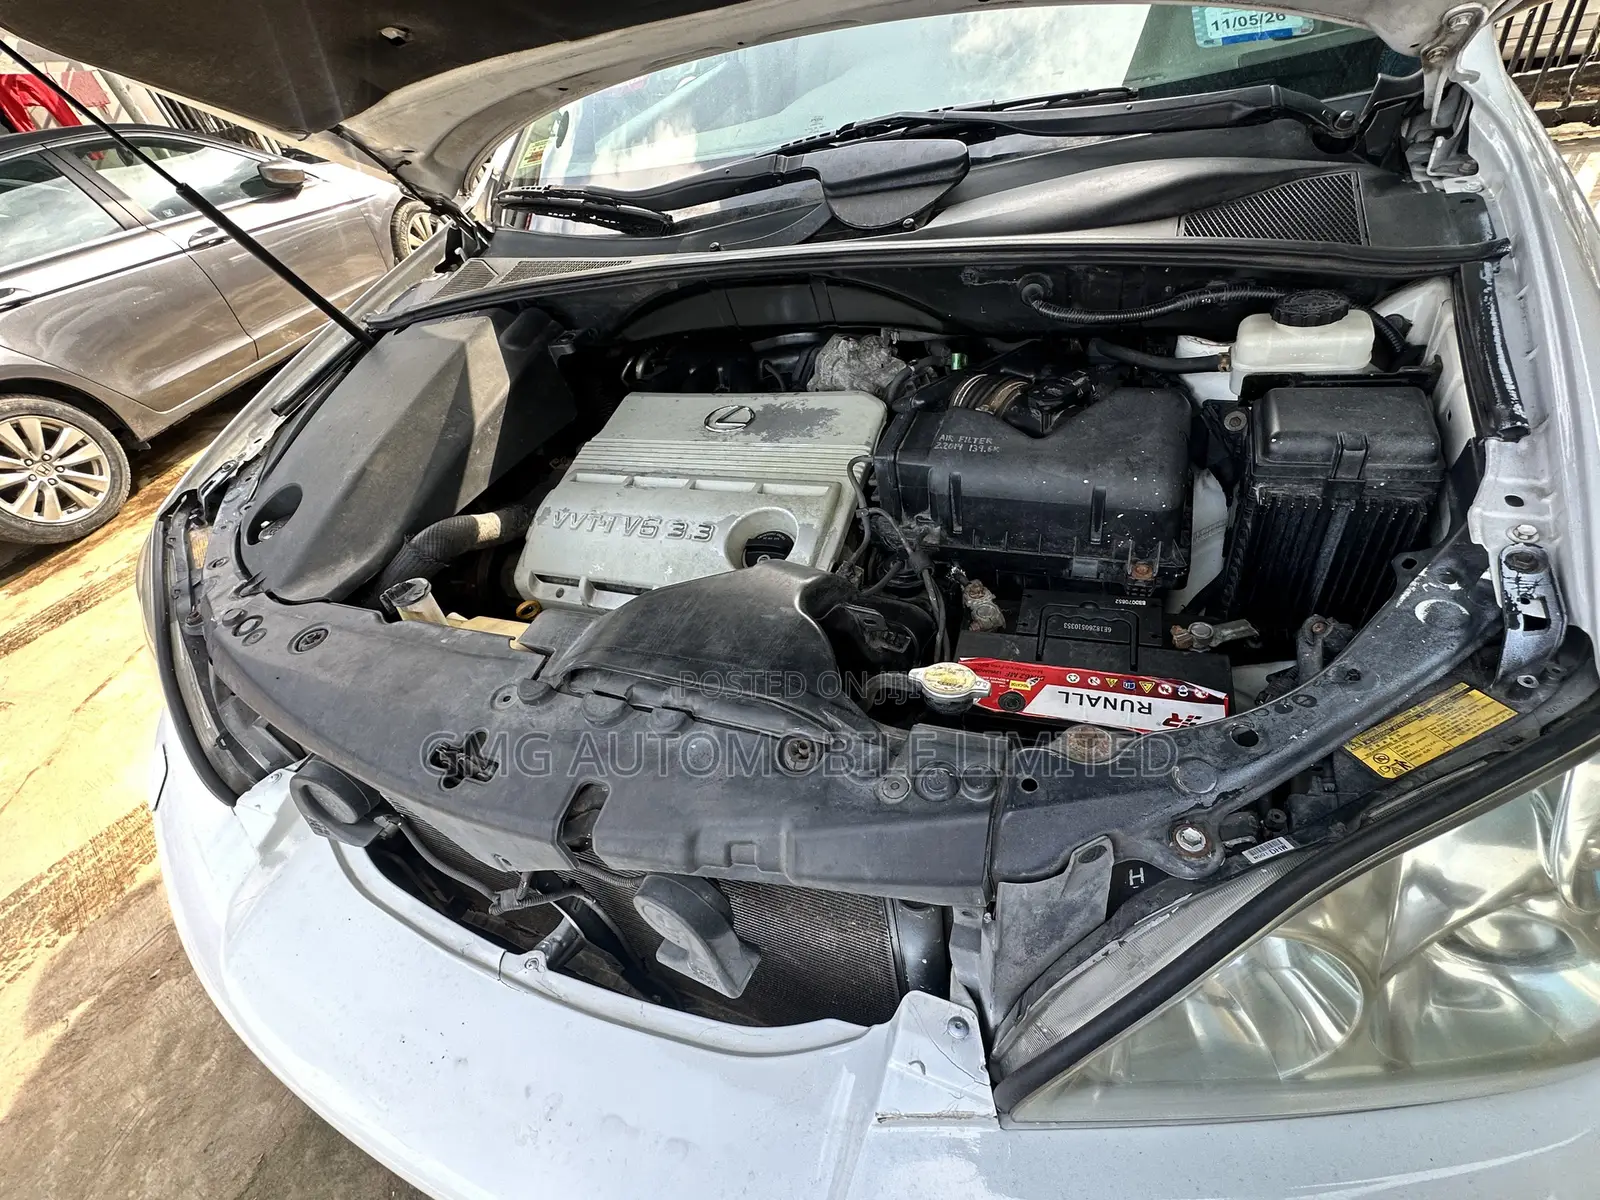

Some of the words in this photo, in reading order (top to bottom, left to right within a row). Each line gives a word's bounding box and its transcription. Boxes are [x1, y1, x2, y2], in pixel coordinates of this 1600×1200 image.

[1211, 12, 1286, 31] 11/05/26
[938, 434, 954, 442] AIR
[958, 435, 993, 445] FILTER
[623, 515, 662, 538] V6
[667, 520, 716, 542] 3.3
[1058, 690, 1152, 715] RUNALL
